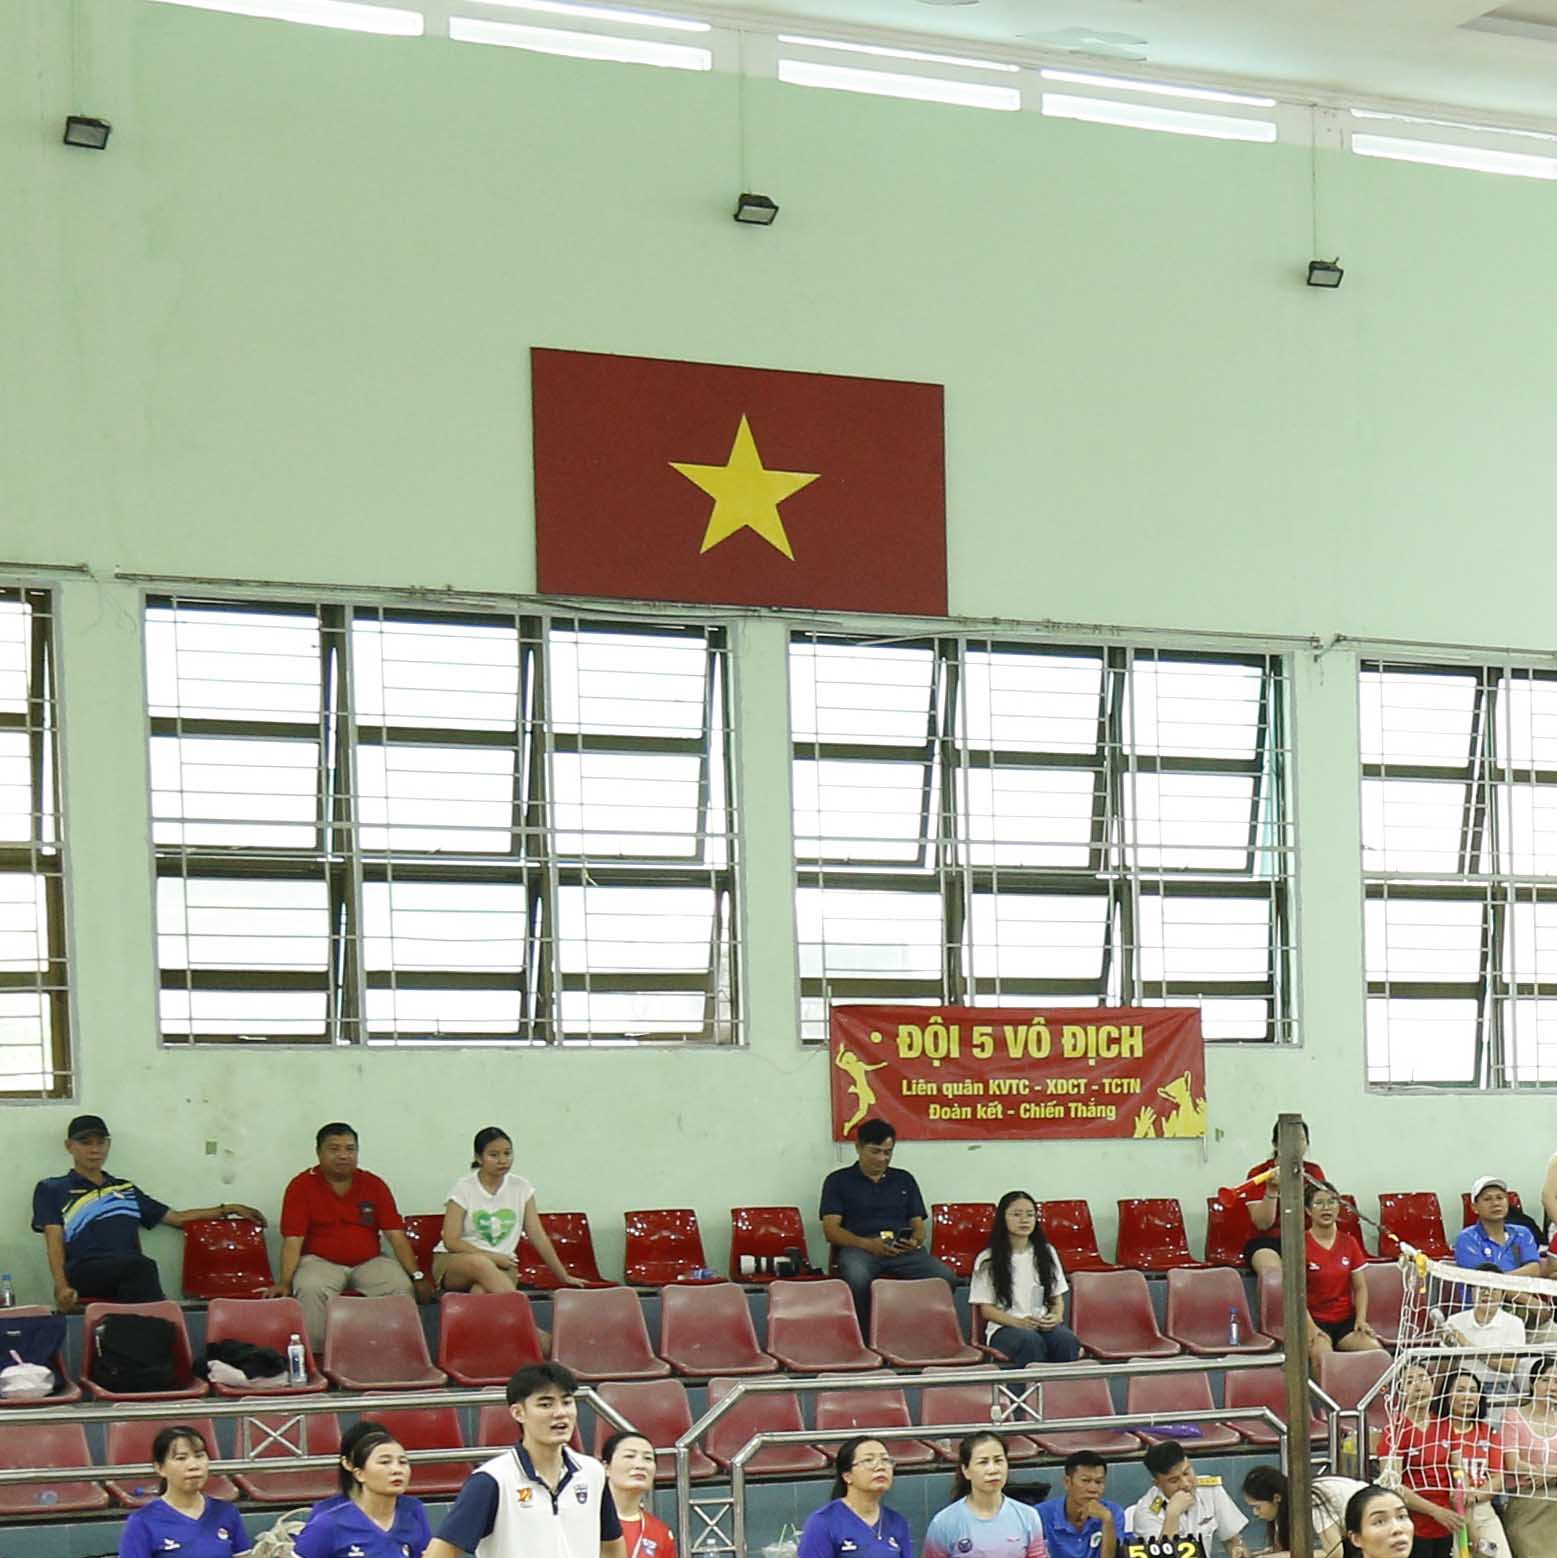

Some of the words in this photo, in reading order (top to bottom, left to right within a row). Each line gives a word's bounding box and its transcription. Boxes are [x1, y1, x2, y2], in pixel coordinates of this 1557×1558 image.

[896, 1016, 960, 1067] ĐỘI
[972, 1026, 994, 1059] 5
[1003, 1016, 1051, 1059] VÔ
[1061, 1025, 1144, 1066] ĐỊCH
[902, 1079, 937, 1096] Liên
[942, 1080, 984, 1098] quân
[988, 1079, 1030, 1095] KVTC
[1102, 1078, 1141, 1094] TCTN
[928, 1103, 971, 1120] Đoàn
[976, 1101, 1003, 1119] kết
[1019, 1100, 1064, 1119] Chiến
[1068, 1097, 1117, 1120] Thắng
